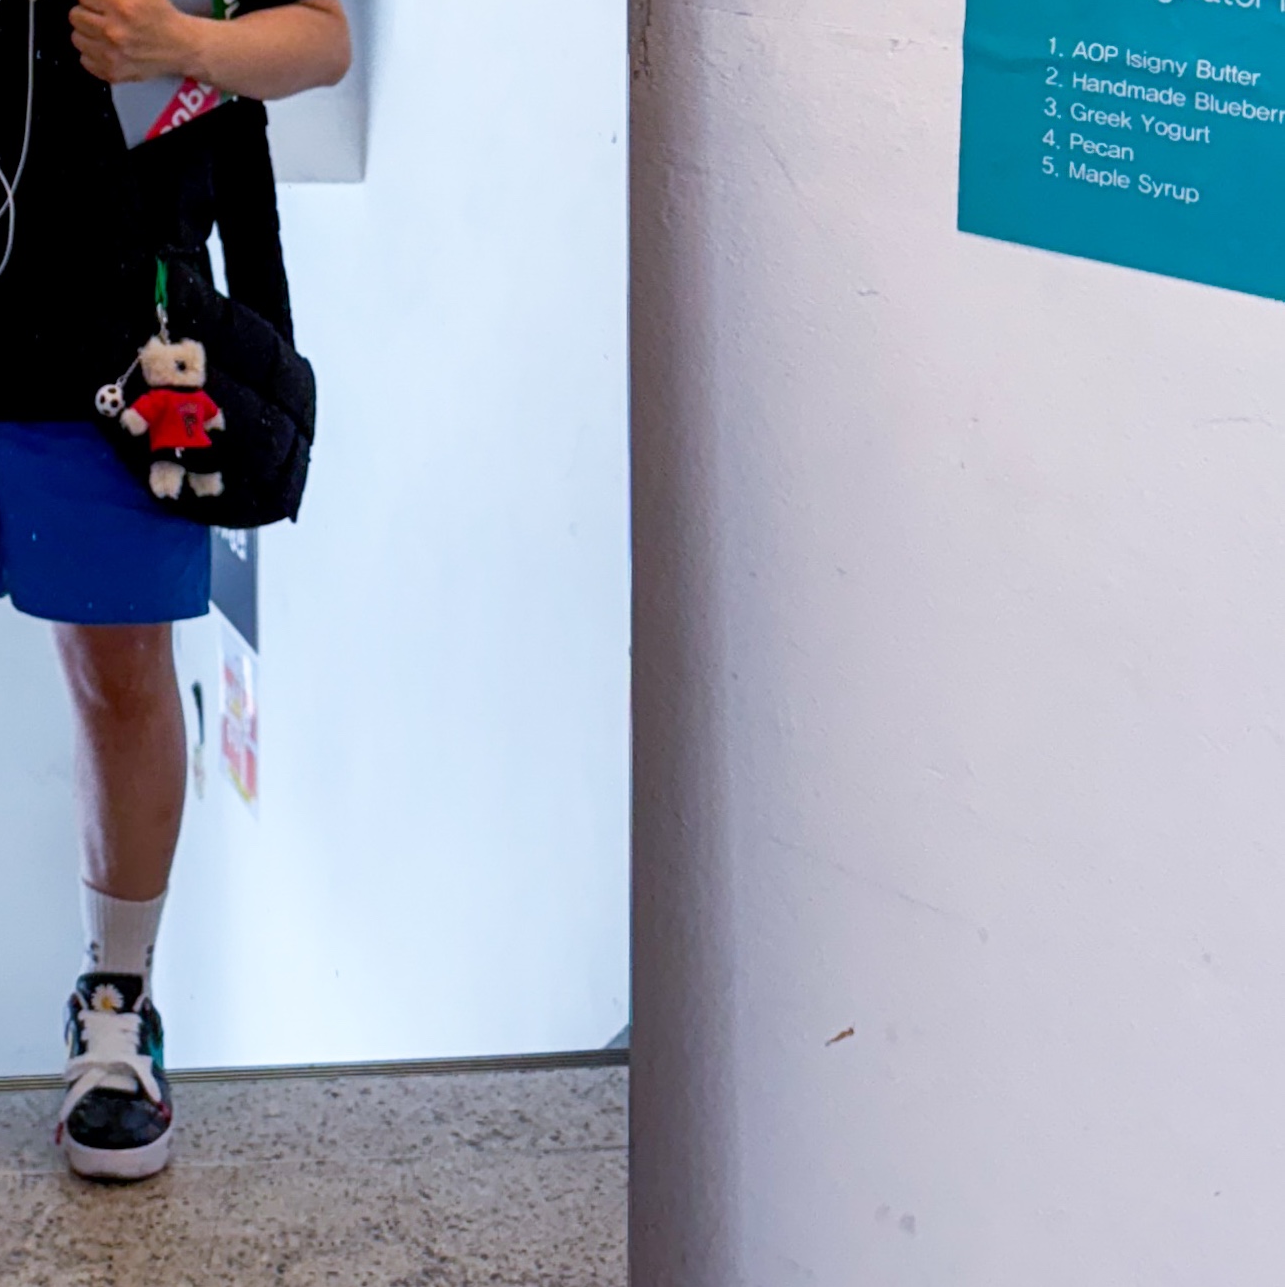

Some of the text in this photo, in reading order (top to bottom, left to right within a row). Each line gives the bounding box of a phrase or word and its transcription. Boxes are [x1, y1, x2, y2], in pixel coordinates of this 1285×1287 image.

[1048, 37, 1261, 87] 1. AOP Isigny Butter
[1045, 67, 1063, 88] 2.
[1072, 72, 1186, 107] Handmade
[1044, 97, 1211, 144] 3. Greek Yogurt
[1042, 129, 1134, 162] 4. Pecan
[1042, 156, 1200, 204] 5. Maple Syrup
